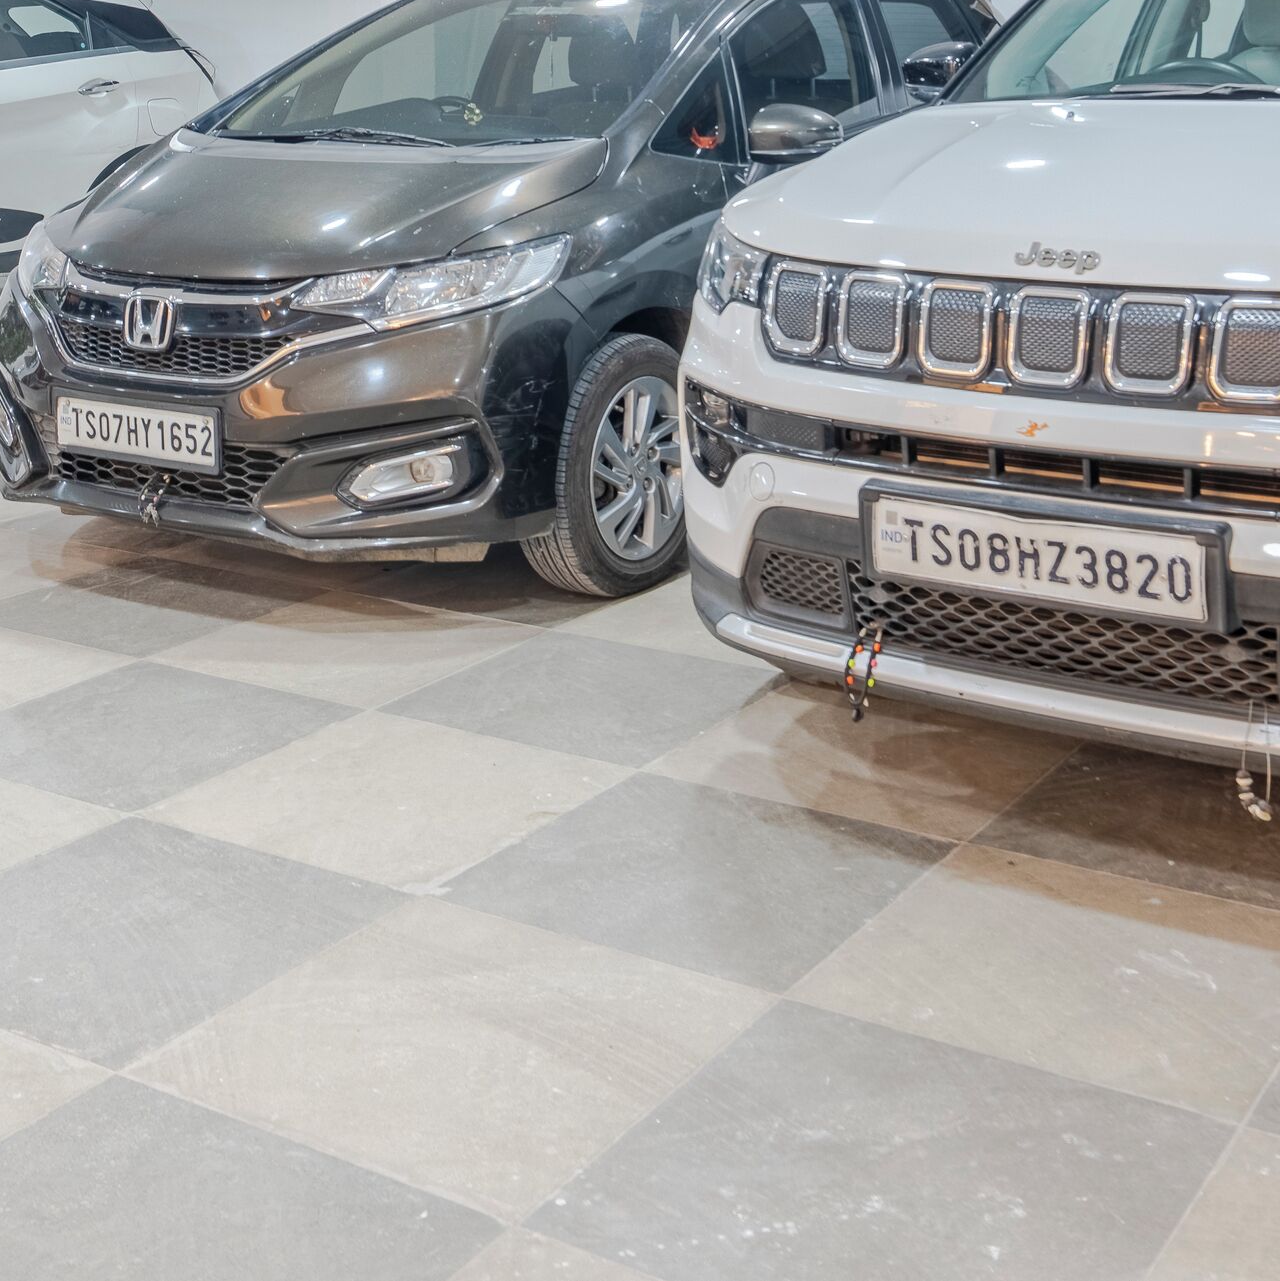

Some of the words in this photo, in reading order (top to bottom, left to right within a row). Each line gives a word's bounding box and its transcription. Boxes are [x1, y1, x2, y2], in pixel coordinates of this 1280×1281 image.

[1014, 241, 1101, 275] Jeep
[72, 407, 213, 457] TS07HY1652
[880, 528, 903, 543] IND
[904, 518, 1193, 603] TS08HZ3820
